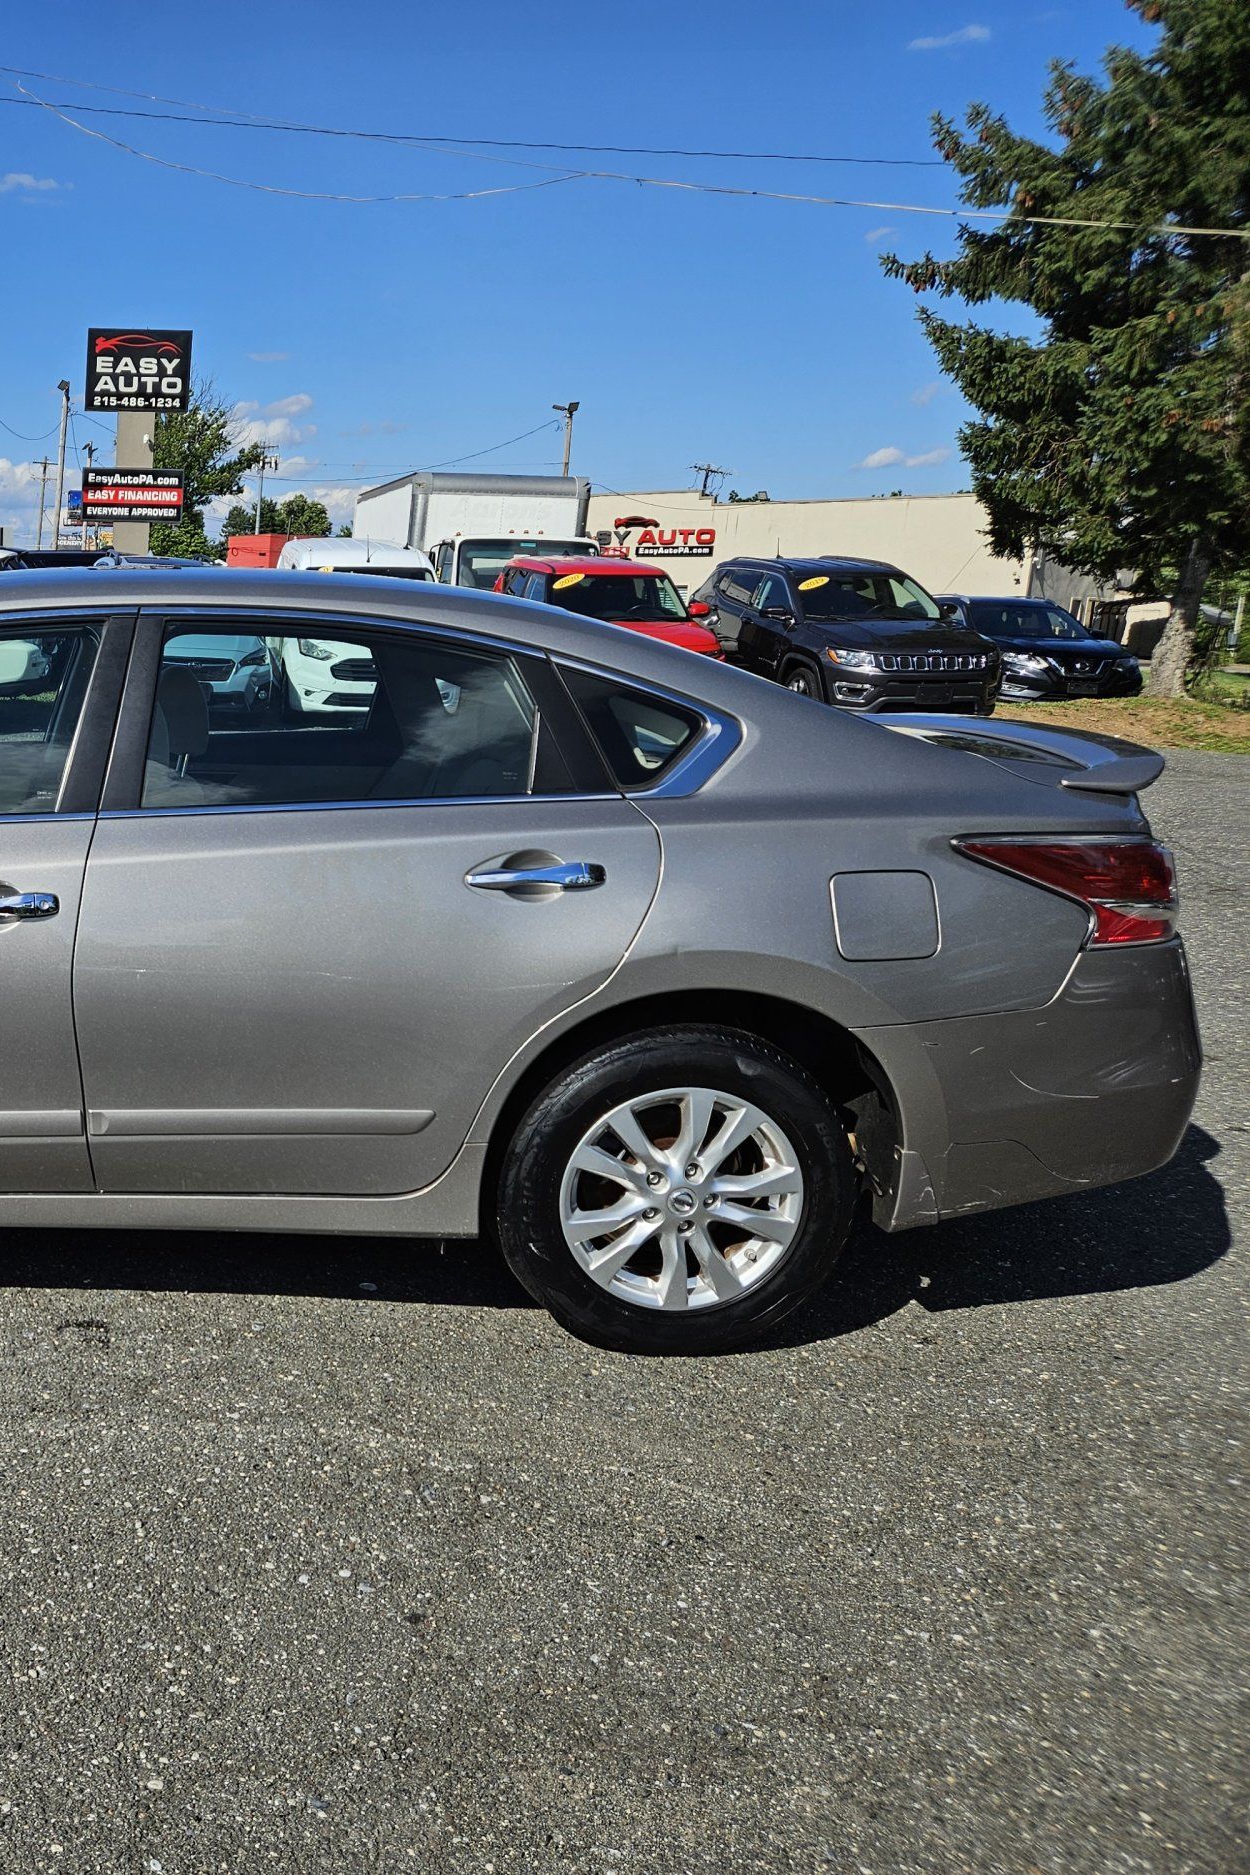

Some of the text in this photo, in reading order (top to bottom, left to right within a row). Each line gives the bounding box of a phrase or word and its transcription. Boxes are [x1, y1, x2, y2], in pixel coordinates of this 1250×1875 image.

[96, 356, 181, 375] EASY
[94, 375, 182, 394] AUTO
[93, 396, 181, 408] 215-486-1234
[88, 472, 179, 485] EasyAutoPA.com
[87, 489, 178, 501] EASY FINANCING
[86, 506, 130, 516] EVERYONE
[131, 507, 178, 517] APPROVED!
[637, 528, 716, 545] AUTO
[637, 546, 710, 556] EasyAutoPA.com
